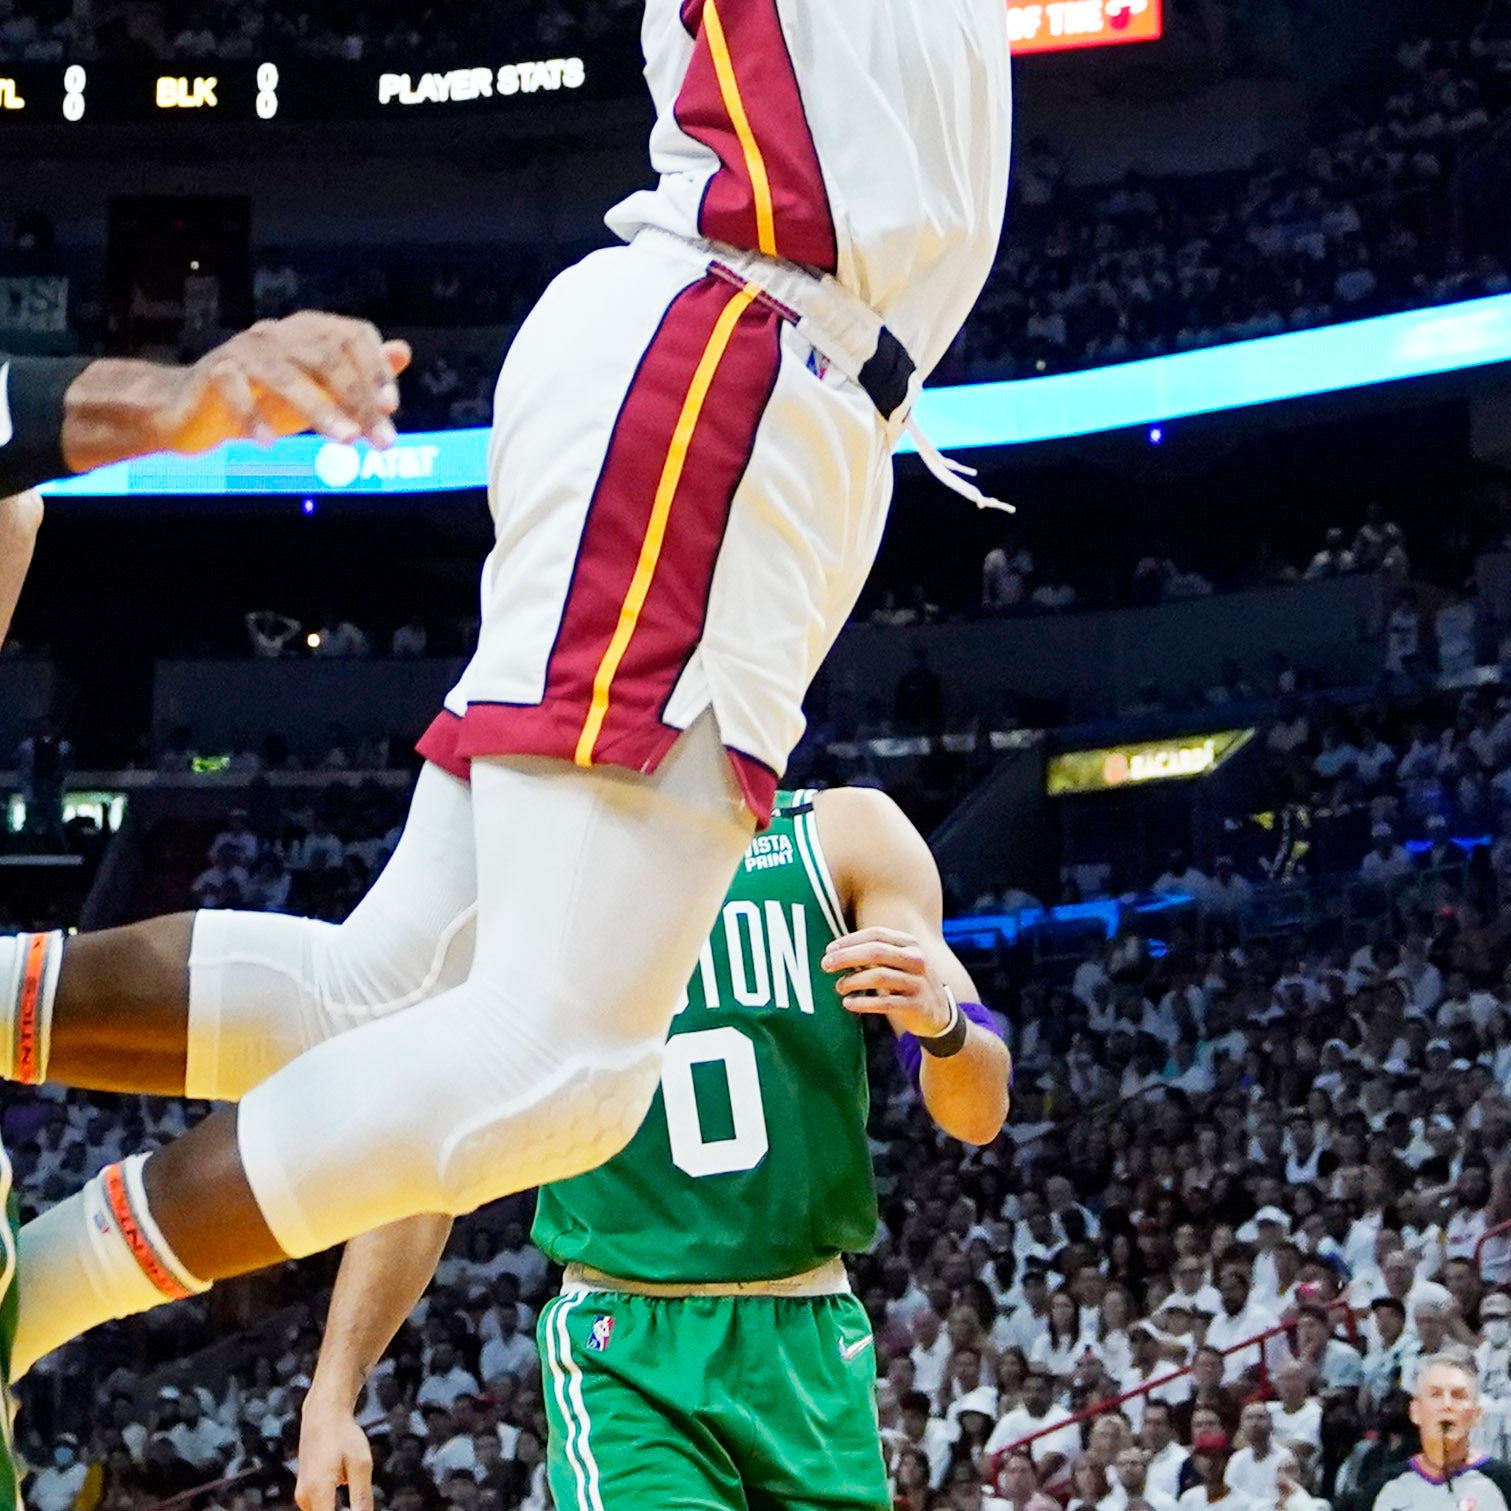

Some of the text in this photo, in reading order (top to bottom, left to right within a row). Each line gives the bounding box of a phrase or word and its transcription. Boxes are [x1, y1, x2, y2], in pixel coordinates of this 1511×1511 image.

[155, 75, 218, 108] BLK
[378, 57, 586, 106] PLAYER STATS
[744, 848, 794, 873] PRINT
[661, 1025, 769, 1178] 0
